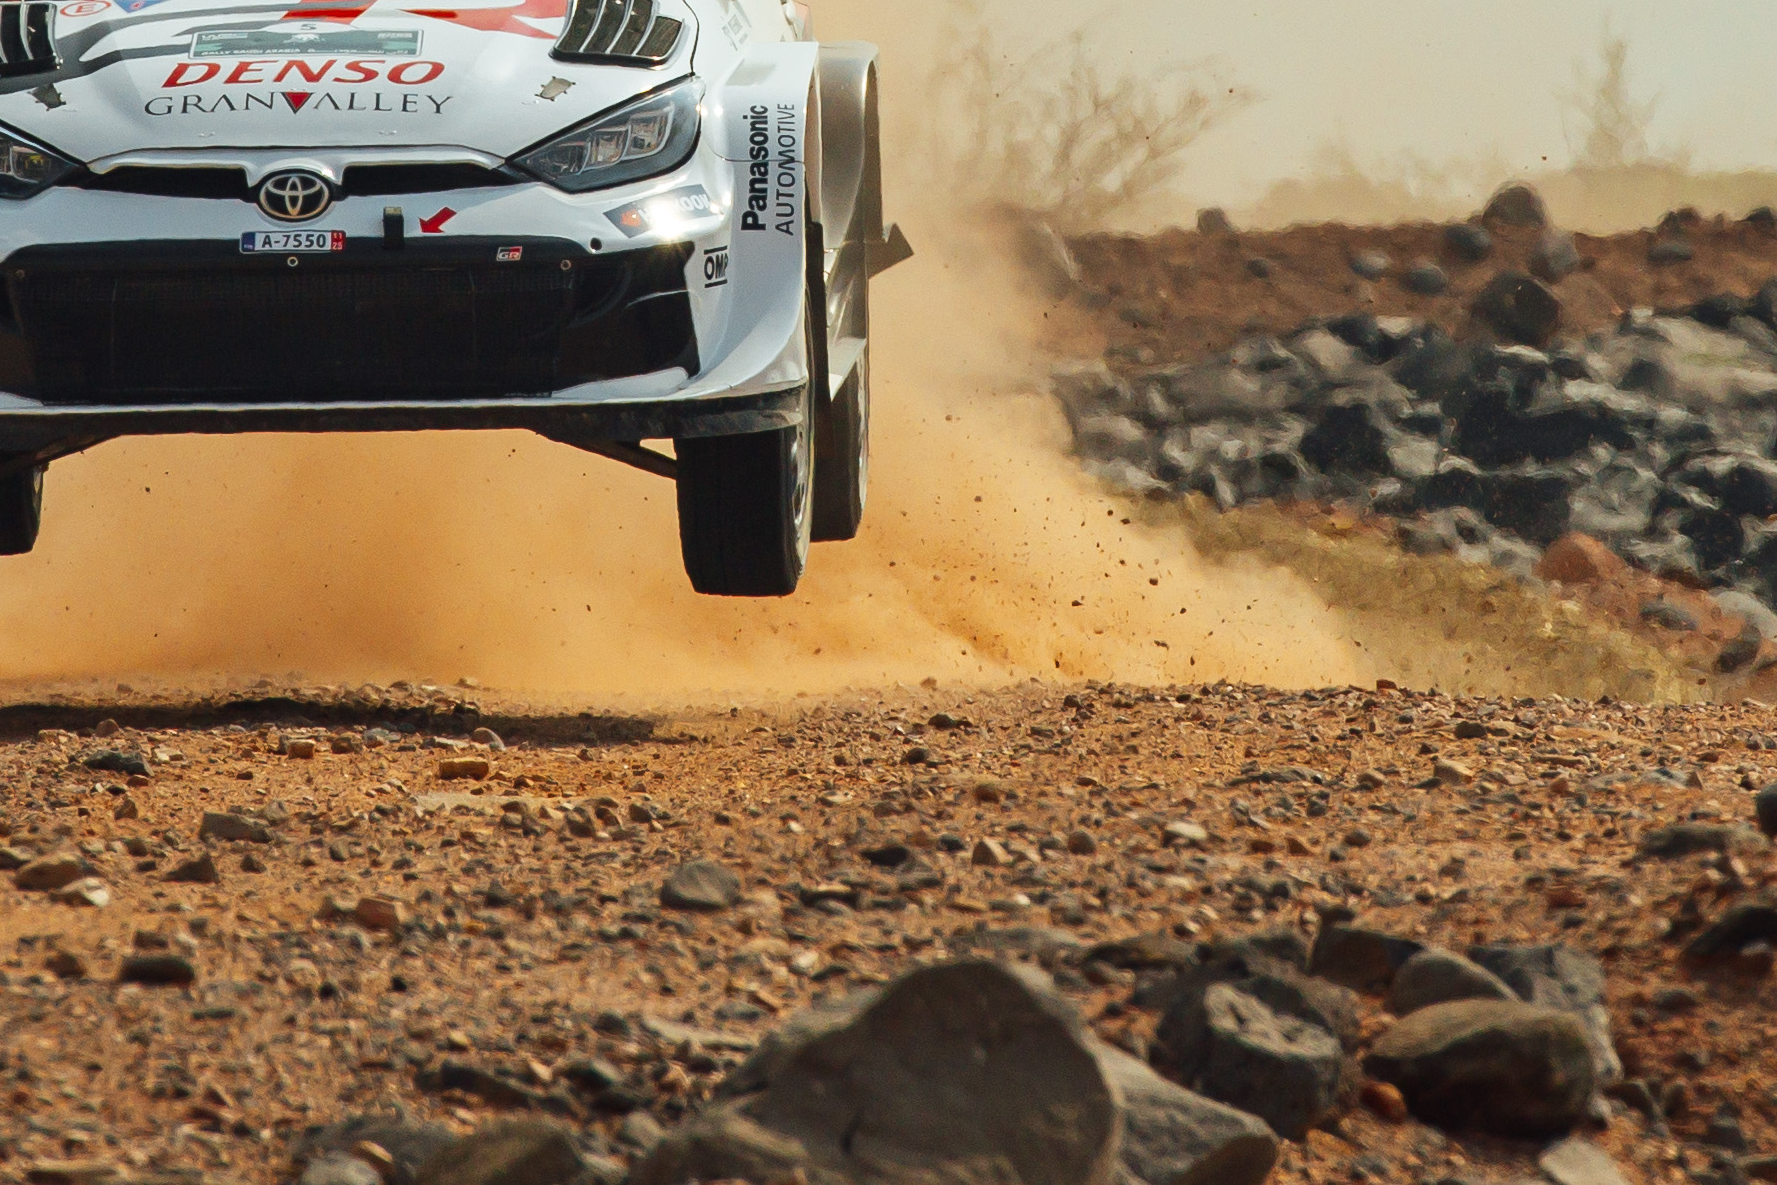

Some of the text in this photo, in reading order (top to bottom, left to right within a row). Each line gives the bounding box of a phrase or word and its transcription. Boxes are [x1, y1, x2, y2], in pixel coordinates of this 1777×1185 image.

[161, 59, 446, 89] DENSO
[740, 104, 769, 231] Panasonic
[775, 103, 796, 236] AUTOMOTIVE
[261, 233, 326, 249] A-7550
[498, 249, 521, 261] GR
[704, 250, 729, 283] OMP
